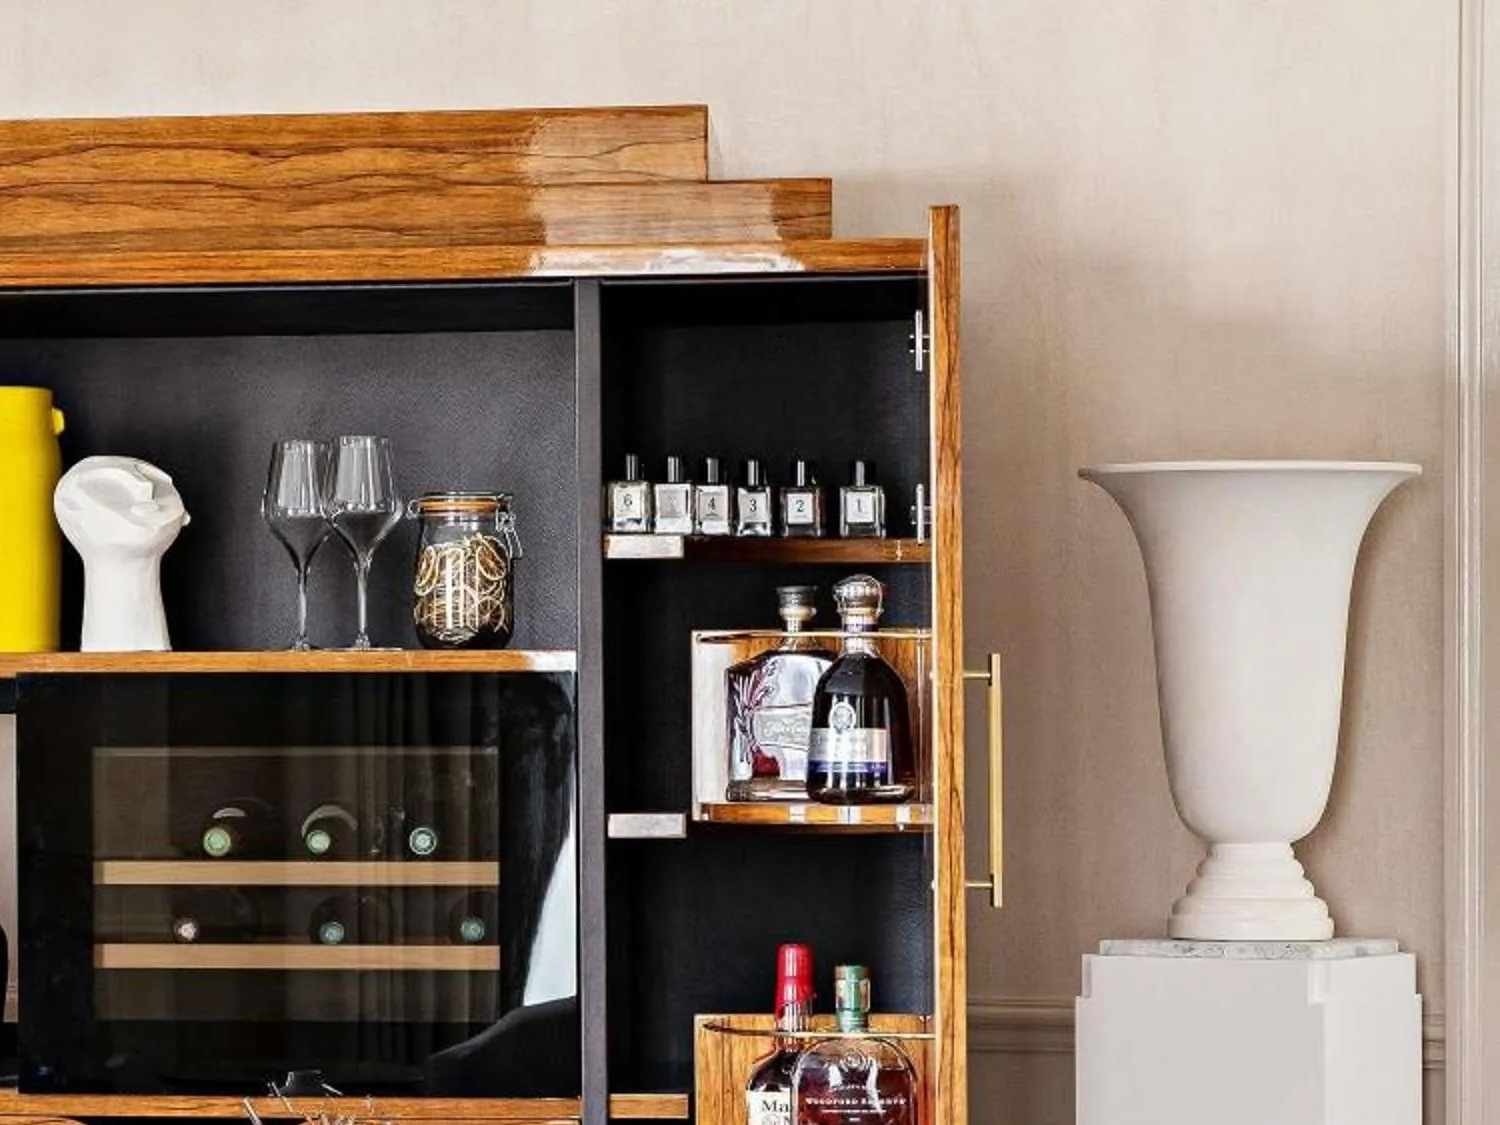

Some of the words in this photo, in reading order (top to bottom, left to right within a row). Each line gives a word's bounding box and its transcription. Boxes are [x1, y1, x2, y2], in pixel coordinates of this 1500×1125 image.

[708, 497, 716, 510] 4
[748, 498, 757, 512] 3
[795, 499, 805, 513] 2
[861, 1097, 907, 1106] REERVE
